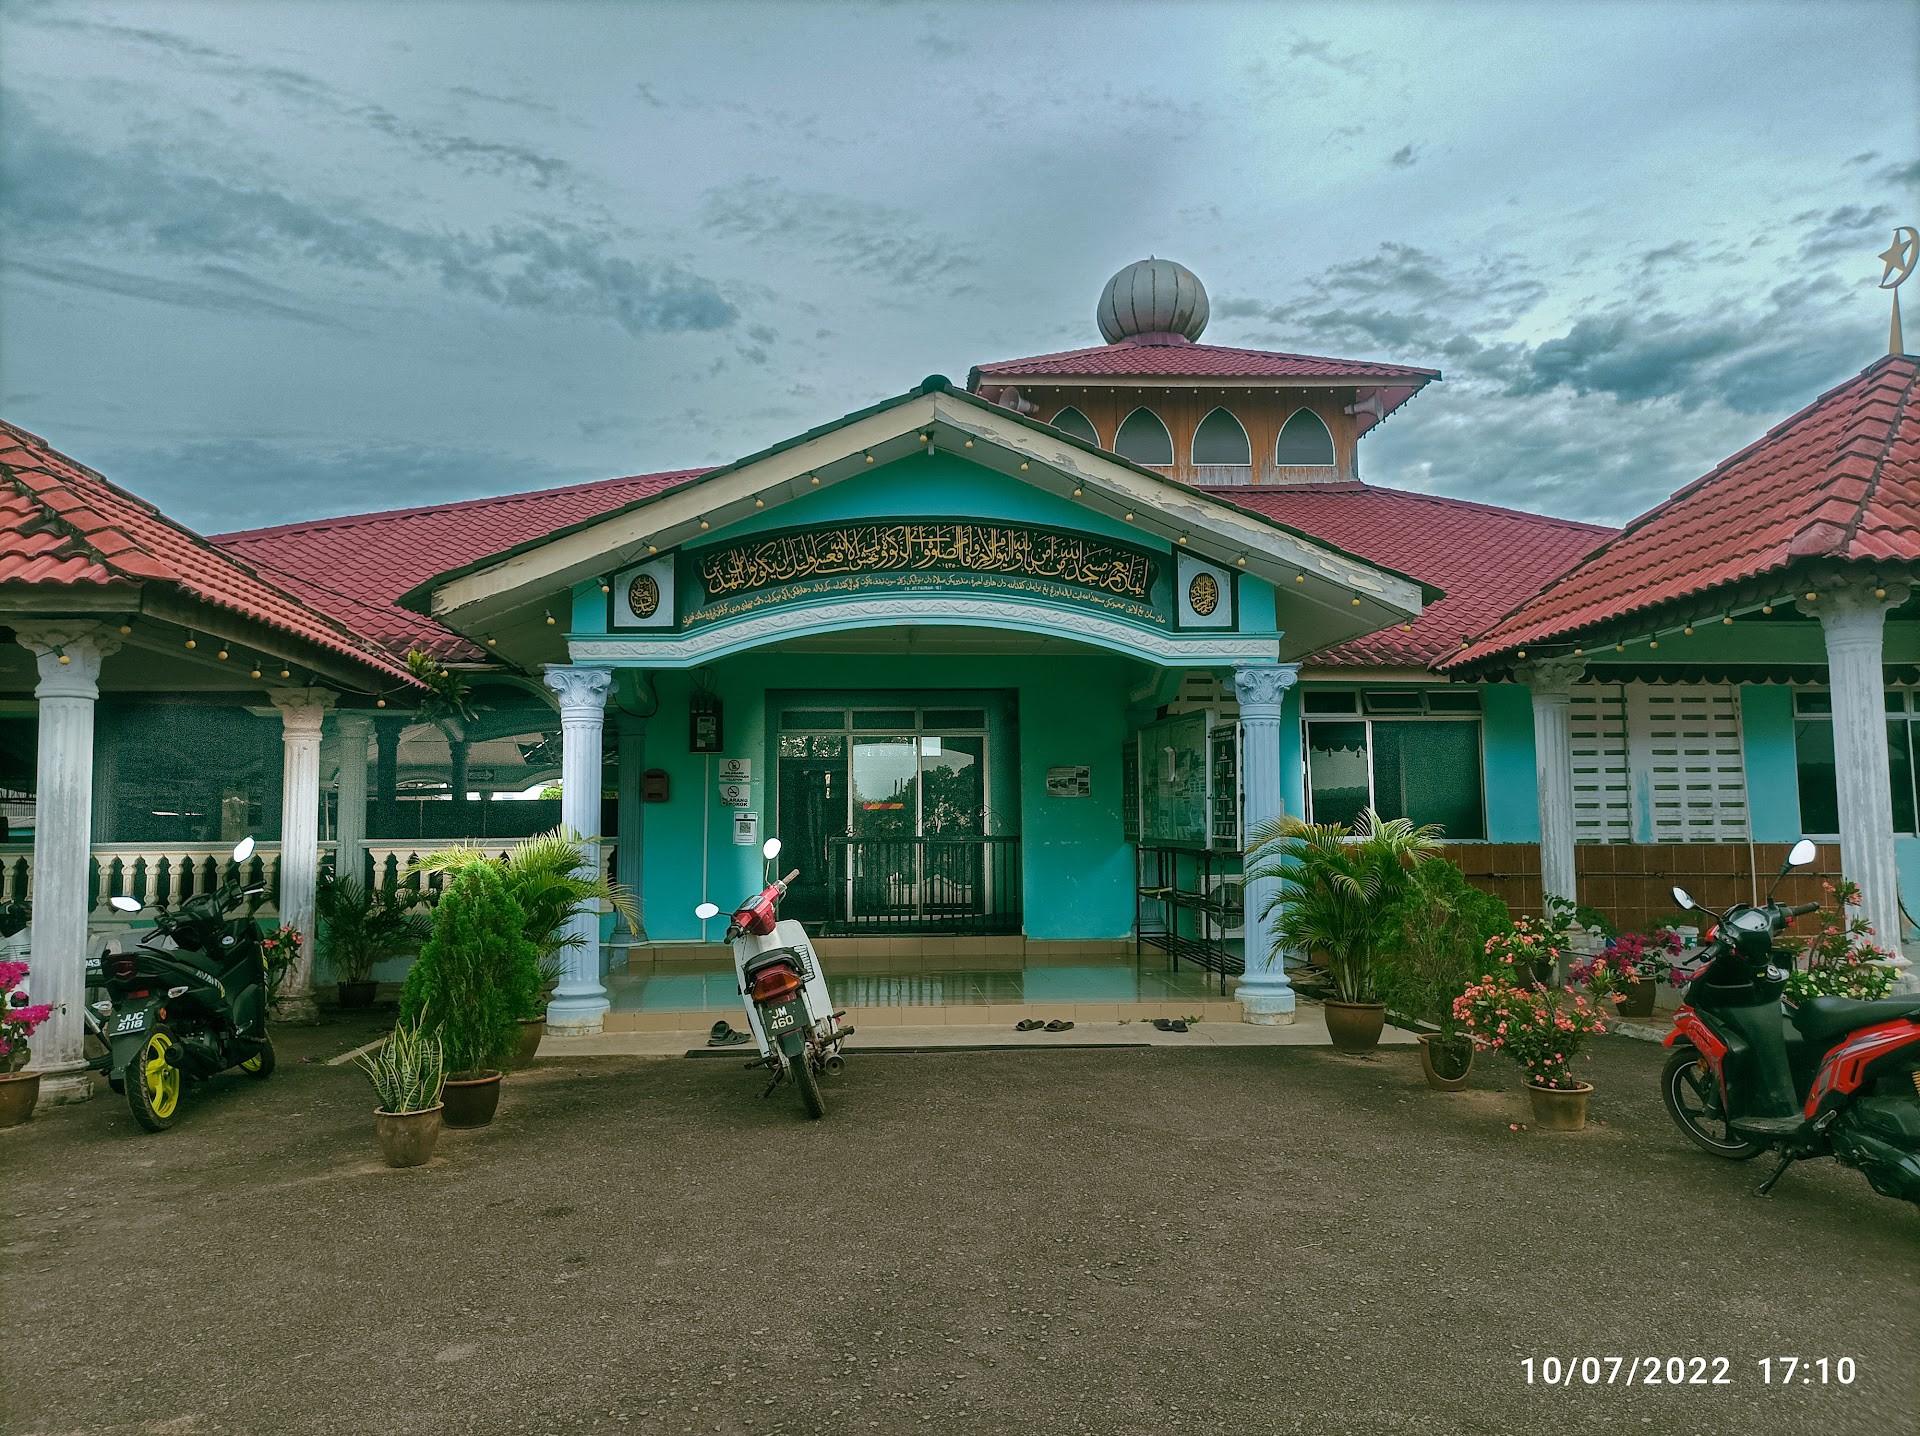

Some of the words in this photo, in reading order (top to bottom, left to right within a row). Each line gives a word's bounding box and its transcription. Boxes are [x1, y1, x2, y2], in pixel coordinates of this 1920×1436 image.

[120, 1011, 145, 1023] JUC
[772, 1006, 788, 1019] JM
[117, 1019, 144, 1031] 5118
[771, 1015, 795, 1030] 460
